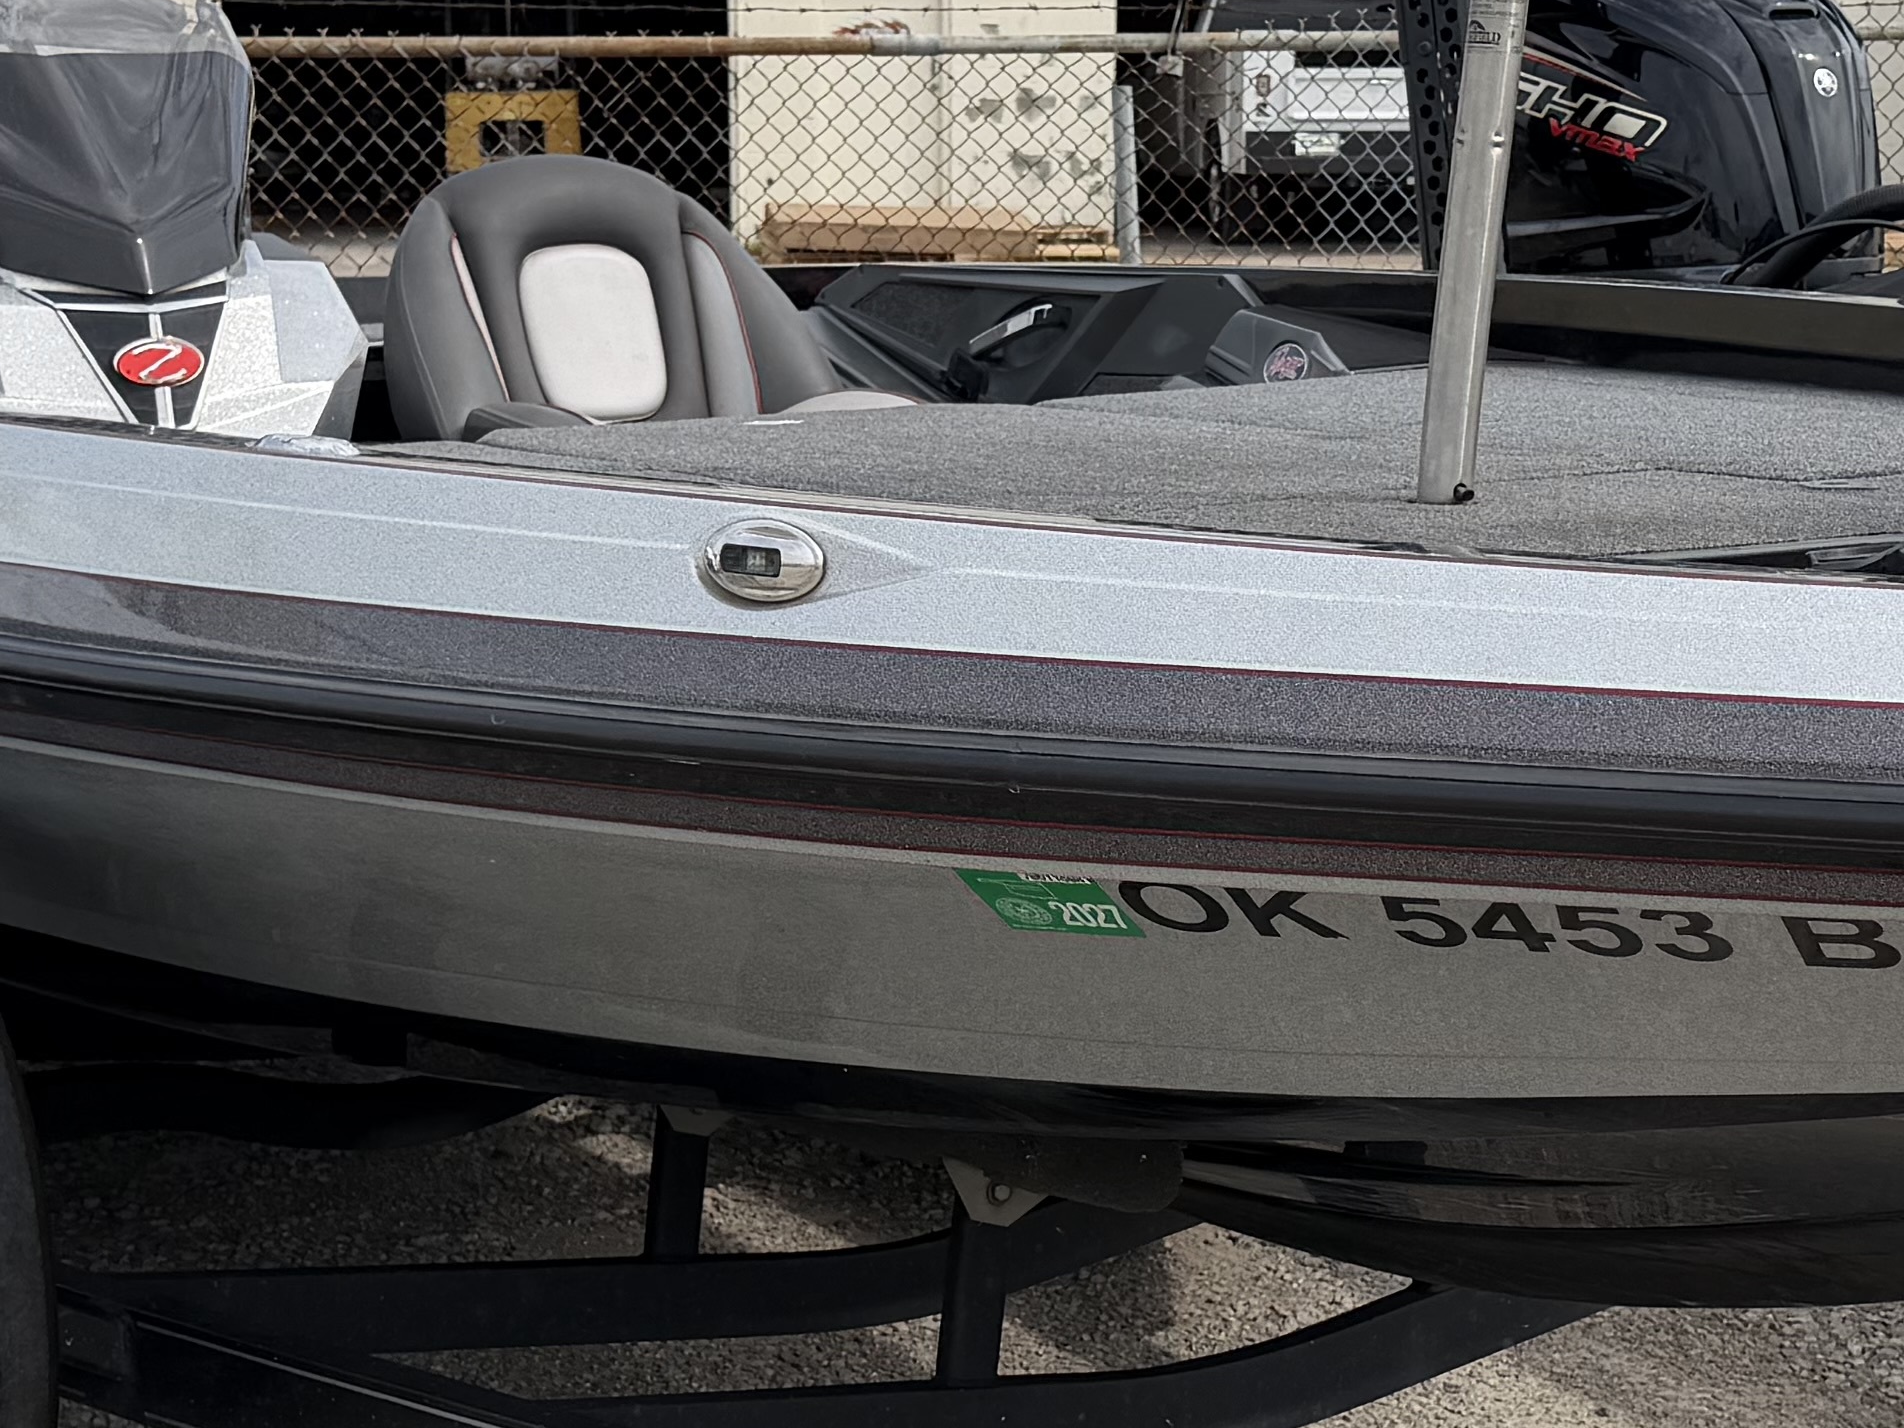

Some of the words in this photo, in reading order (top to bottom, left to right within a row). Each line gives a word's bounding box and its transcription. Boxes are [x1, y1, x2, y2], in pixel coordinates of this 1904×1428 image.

[1048, 900, 1128, 930] 2027
[1118, 880, 1350, 942] OK
[1381, 896, 1734, 963] 5453
